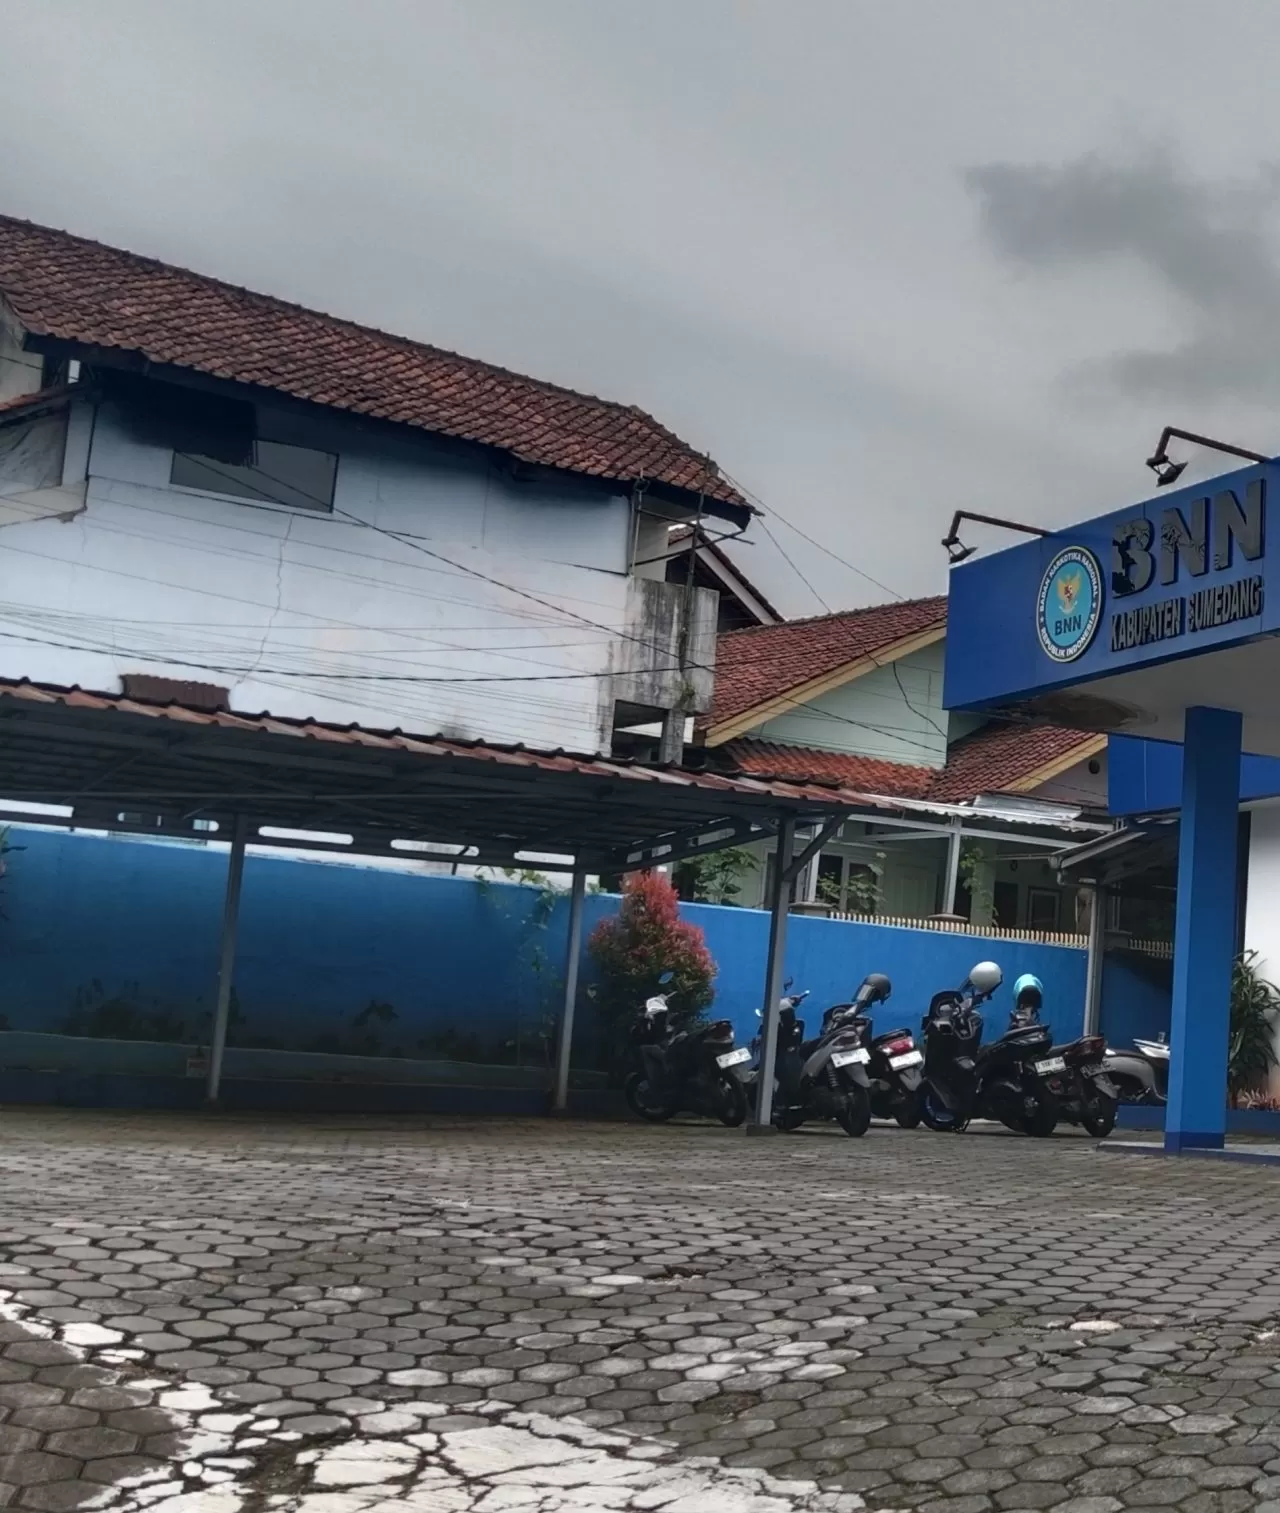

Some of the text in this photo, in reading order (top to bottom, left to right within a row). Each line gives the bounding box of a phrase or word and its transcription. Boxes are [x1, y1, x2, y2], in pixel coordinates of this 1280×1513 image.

[1112, 477, 1266, 599] BNN
[1040, 551, 1098, 612] BADAN NARKOTIKA NASIONAL
[1041, 613, 1096, 657] REPUBLIK INDONESIA
[1054, 614, 1082, 636] BNN
[1111, 575, 1264, 652] KABUPATEN SUMEDANG
